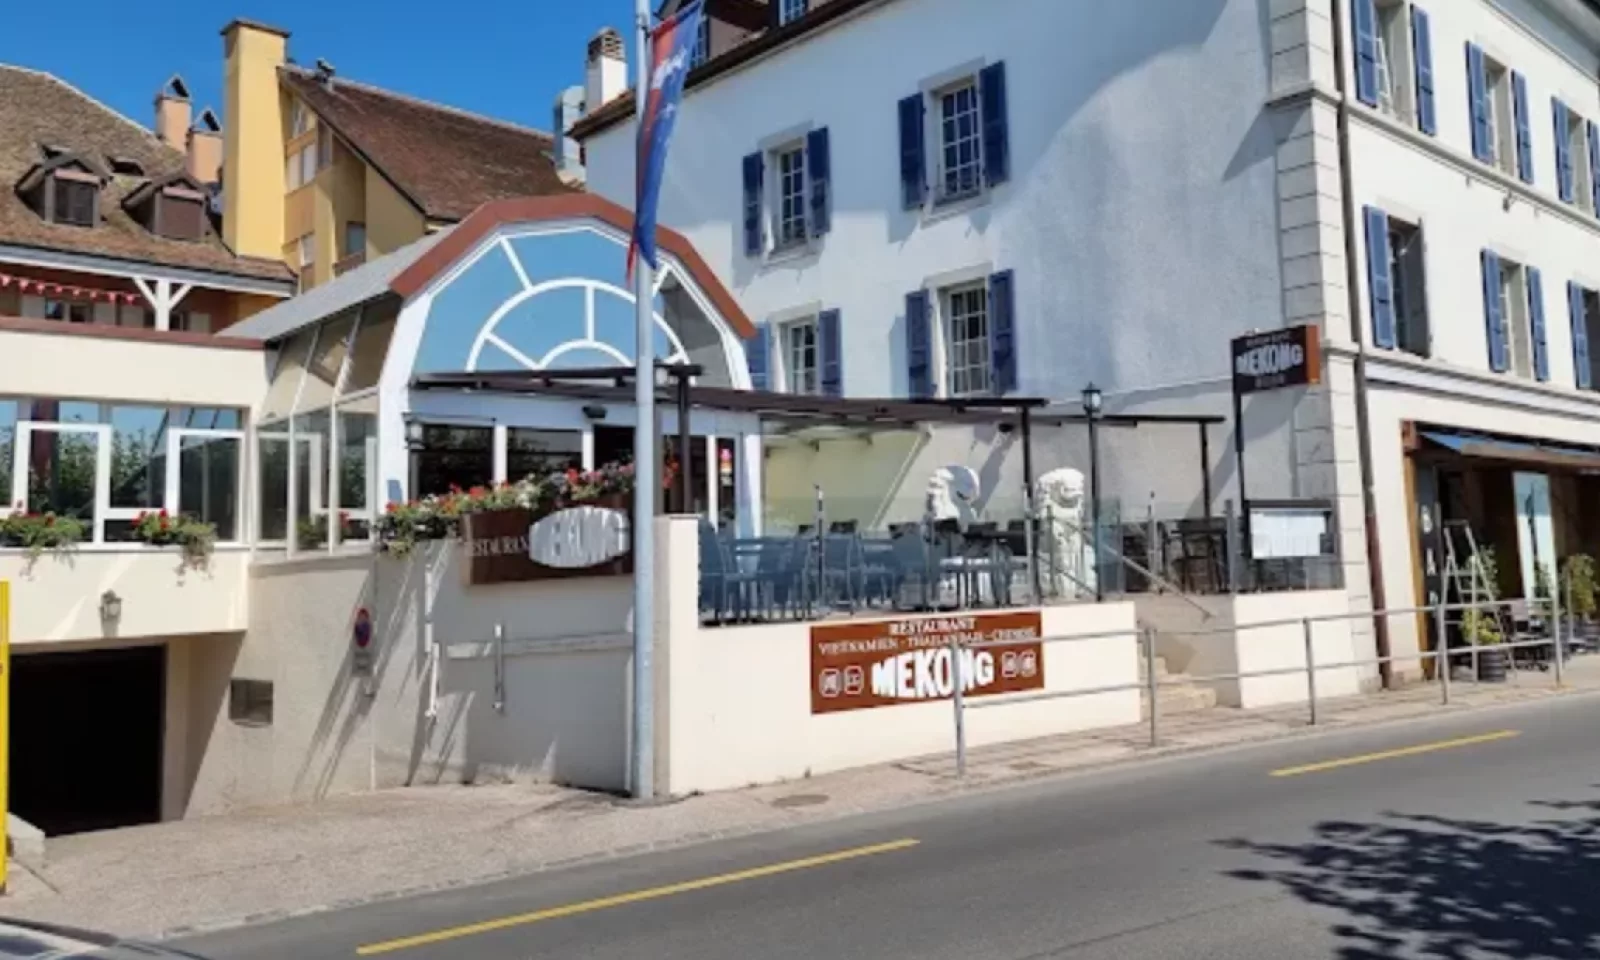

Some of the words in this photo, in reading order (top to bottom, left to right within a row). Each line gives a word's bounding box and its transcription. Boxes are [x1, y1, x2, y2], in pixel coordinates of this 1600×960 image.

[1236, 342, 1304, 376] MEKONG
[889, 617, 976, 635] RESTAURANT
[871, 649, 994, 698] MEKONG
